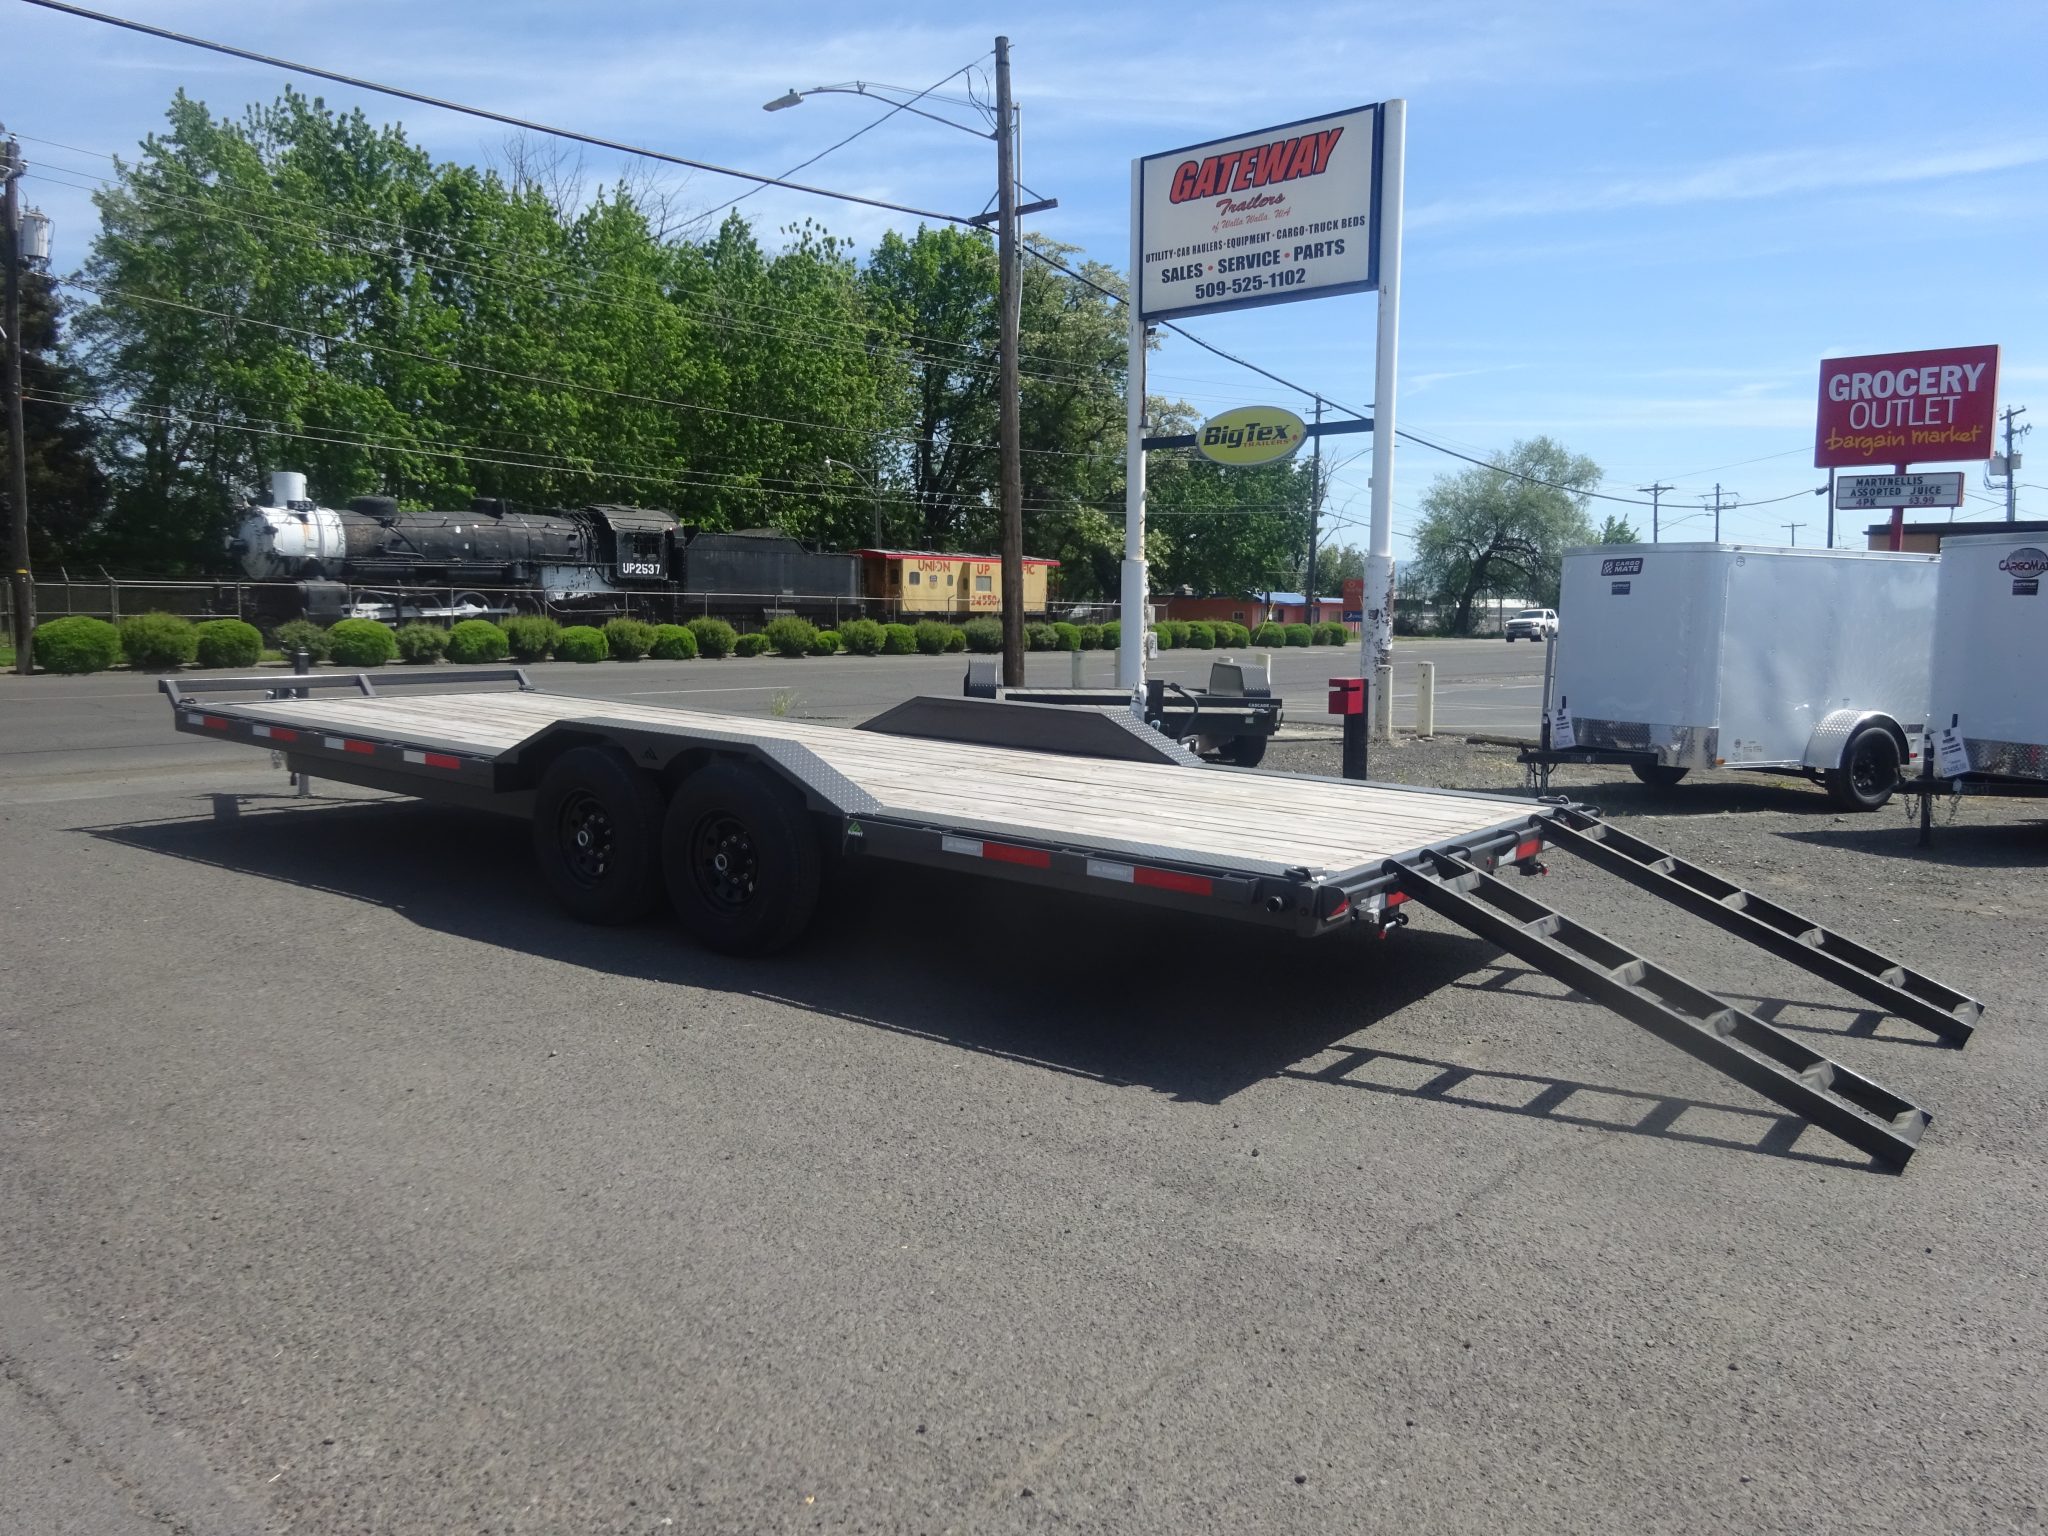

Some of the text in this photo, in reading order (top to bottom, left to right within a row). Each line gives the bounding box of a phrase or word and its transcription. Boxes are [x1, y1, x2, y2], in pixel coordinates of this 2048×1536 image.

[1170, 127, 1344, 204] GATEWAY
[1216, 192, 1286, 216] Trailers
[1145, 249, 1174, 263] UTILITY
[1192, 240, 1223, 255] HAULERS
[1226, 231, 1271, 249] EQUIPMENT
[1276, 225, 1305, 240] CARGO
[1308, 219, 1339, 235] TRUCK
[1341, 215, 1366, 229] BEDS
[1161, 238, 1346, 284] SALES SERVICE PARTS
[1195, 267, 1307, 300] 509-525-1102
[1828, 362, 1986, 402] GROCERY
[1849, 395, 1961, 430] OUTLET
[1243, 440, 1289, 448] TRAILERS
[1825, 424, 1981, 457] bargain market
[1850, 486, 1942, 498] ASSORTED JUICE
[1855, 475, 1924, 488] MARTINELLIS
[1855, 498, 1876, 507] 4PK
[622, 562, 661, 575] UP2537
[917, 559, 951, 573] UNION
[976, 563, 991, 575] UP
